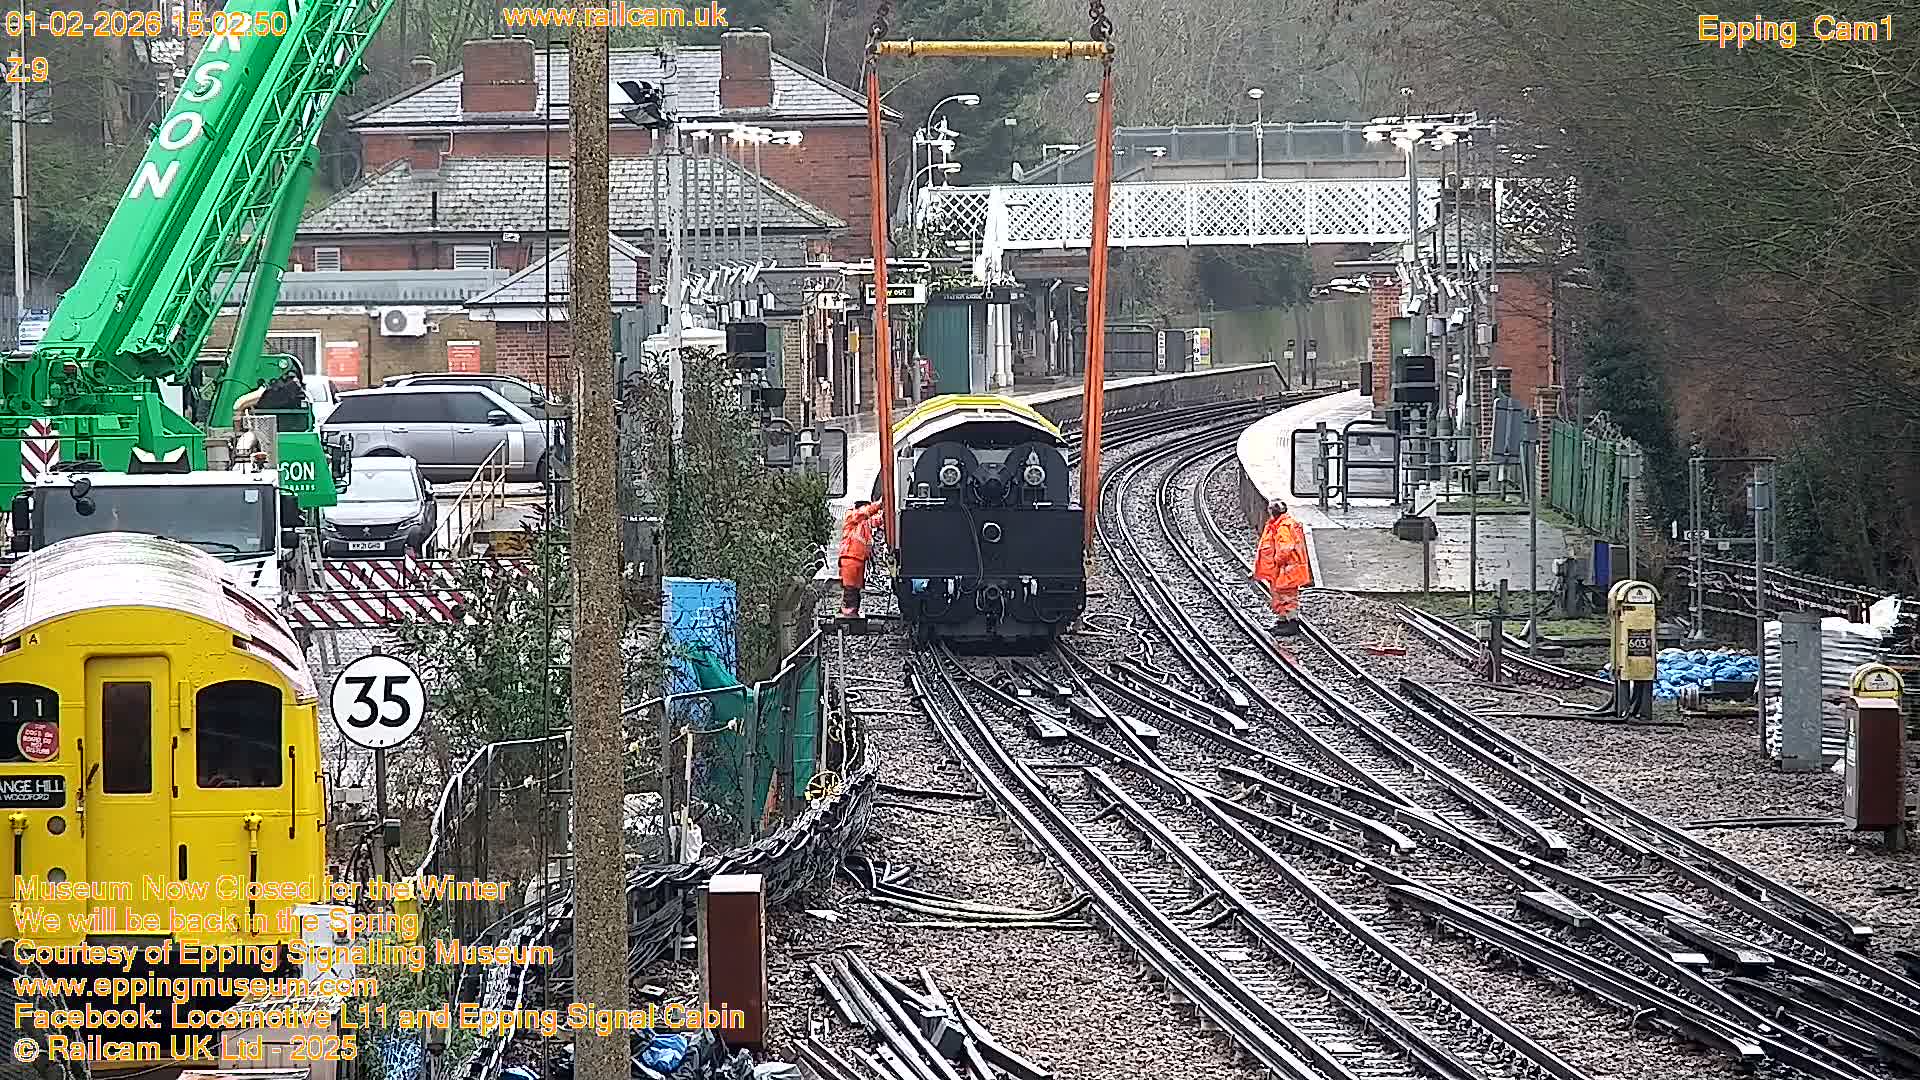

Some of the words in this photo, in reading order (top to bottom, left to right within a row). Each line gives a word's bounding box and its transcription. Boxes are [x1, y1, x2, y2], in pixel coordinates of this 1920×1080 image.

[29, 633, 38, 645] A
[35, 699, 42, 717] 1
[345, 675, 411, 728] 35
[36, 779, 64, 793] HILL
